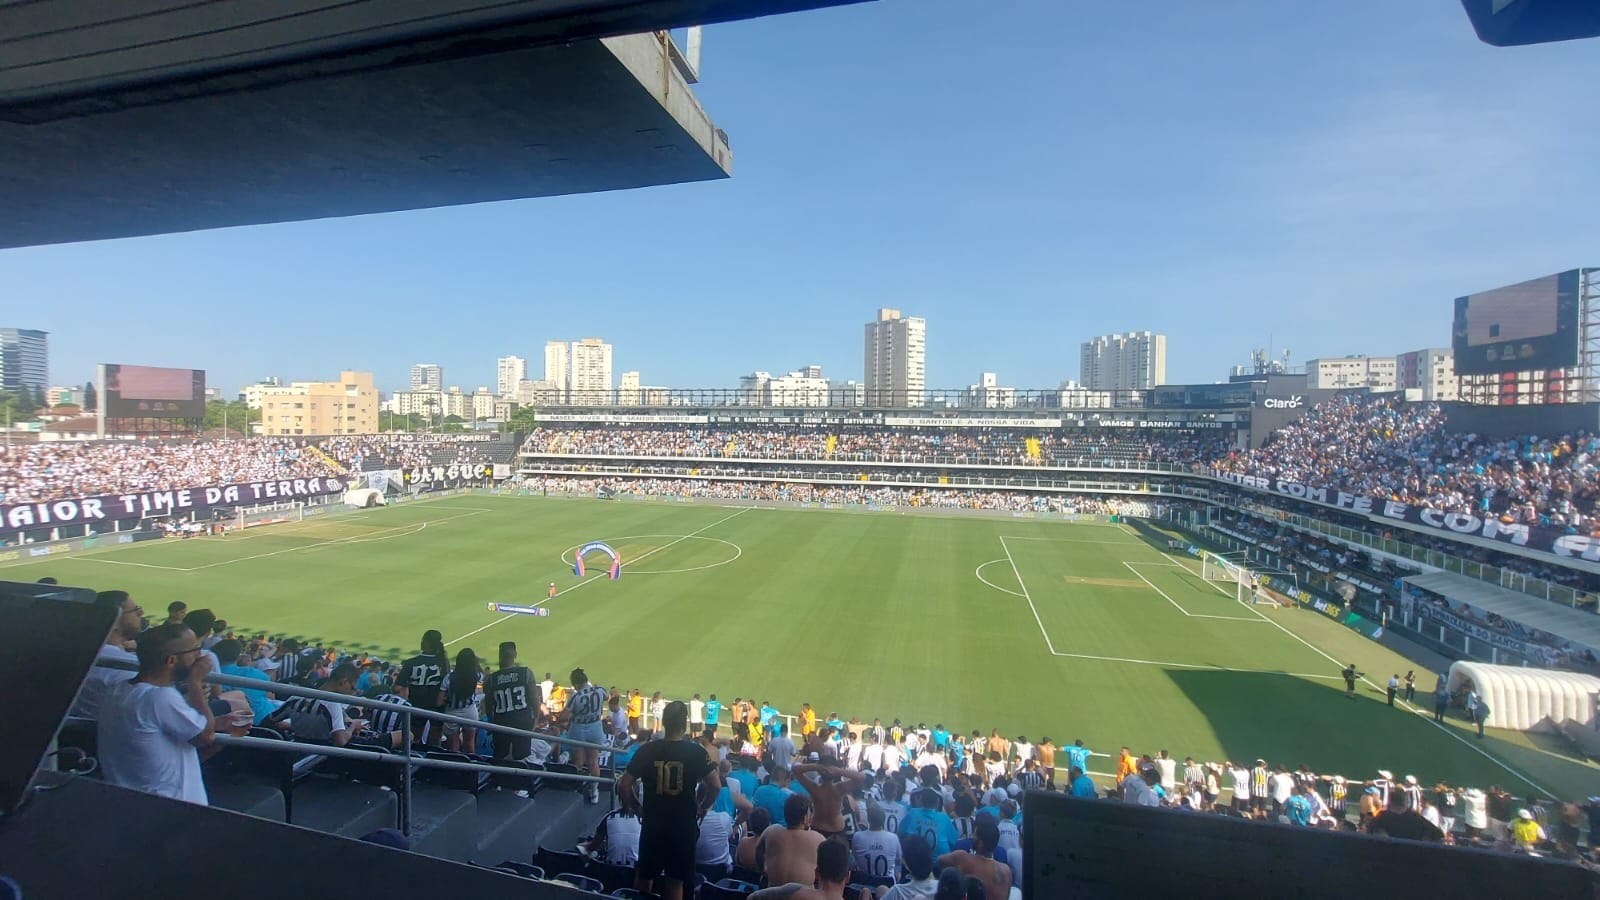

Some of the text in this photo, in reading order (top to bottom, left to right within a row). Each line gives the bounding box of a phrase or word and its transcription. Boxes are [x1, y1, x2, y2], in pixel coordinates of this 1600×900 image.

[1264, 398, 1297, 409] Claro
[0, 478, 321, 528] AIOR TIME DA TERRA
[1276, 480, 1327, 502] COM
[1384, 500, 1408, 520] E
[1420, 507, 1529, 546] COM
[1313, 597, 1341, 618] bet365
[410, 664, 442, 686] 92
[494, 686, 528, 714] 013
[580, 692, 600, 715] 30
[654, 760, 684, 796] 10
[864, 854, 888, 877] 10
